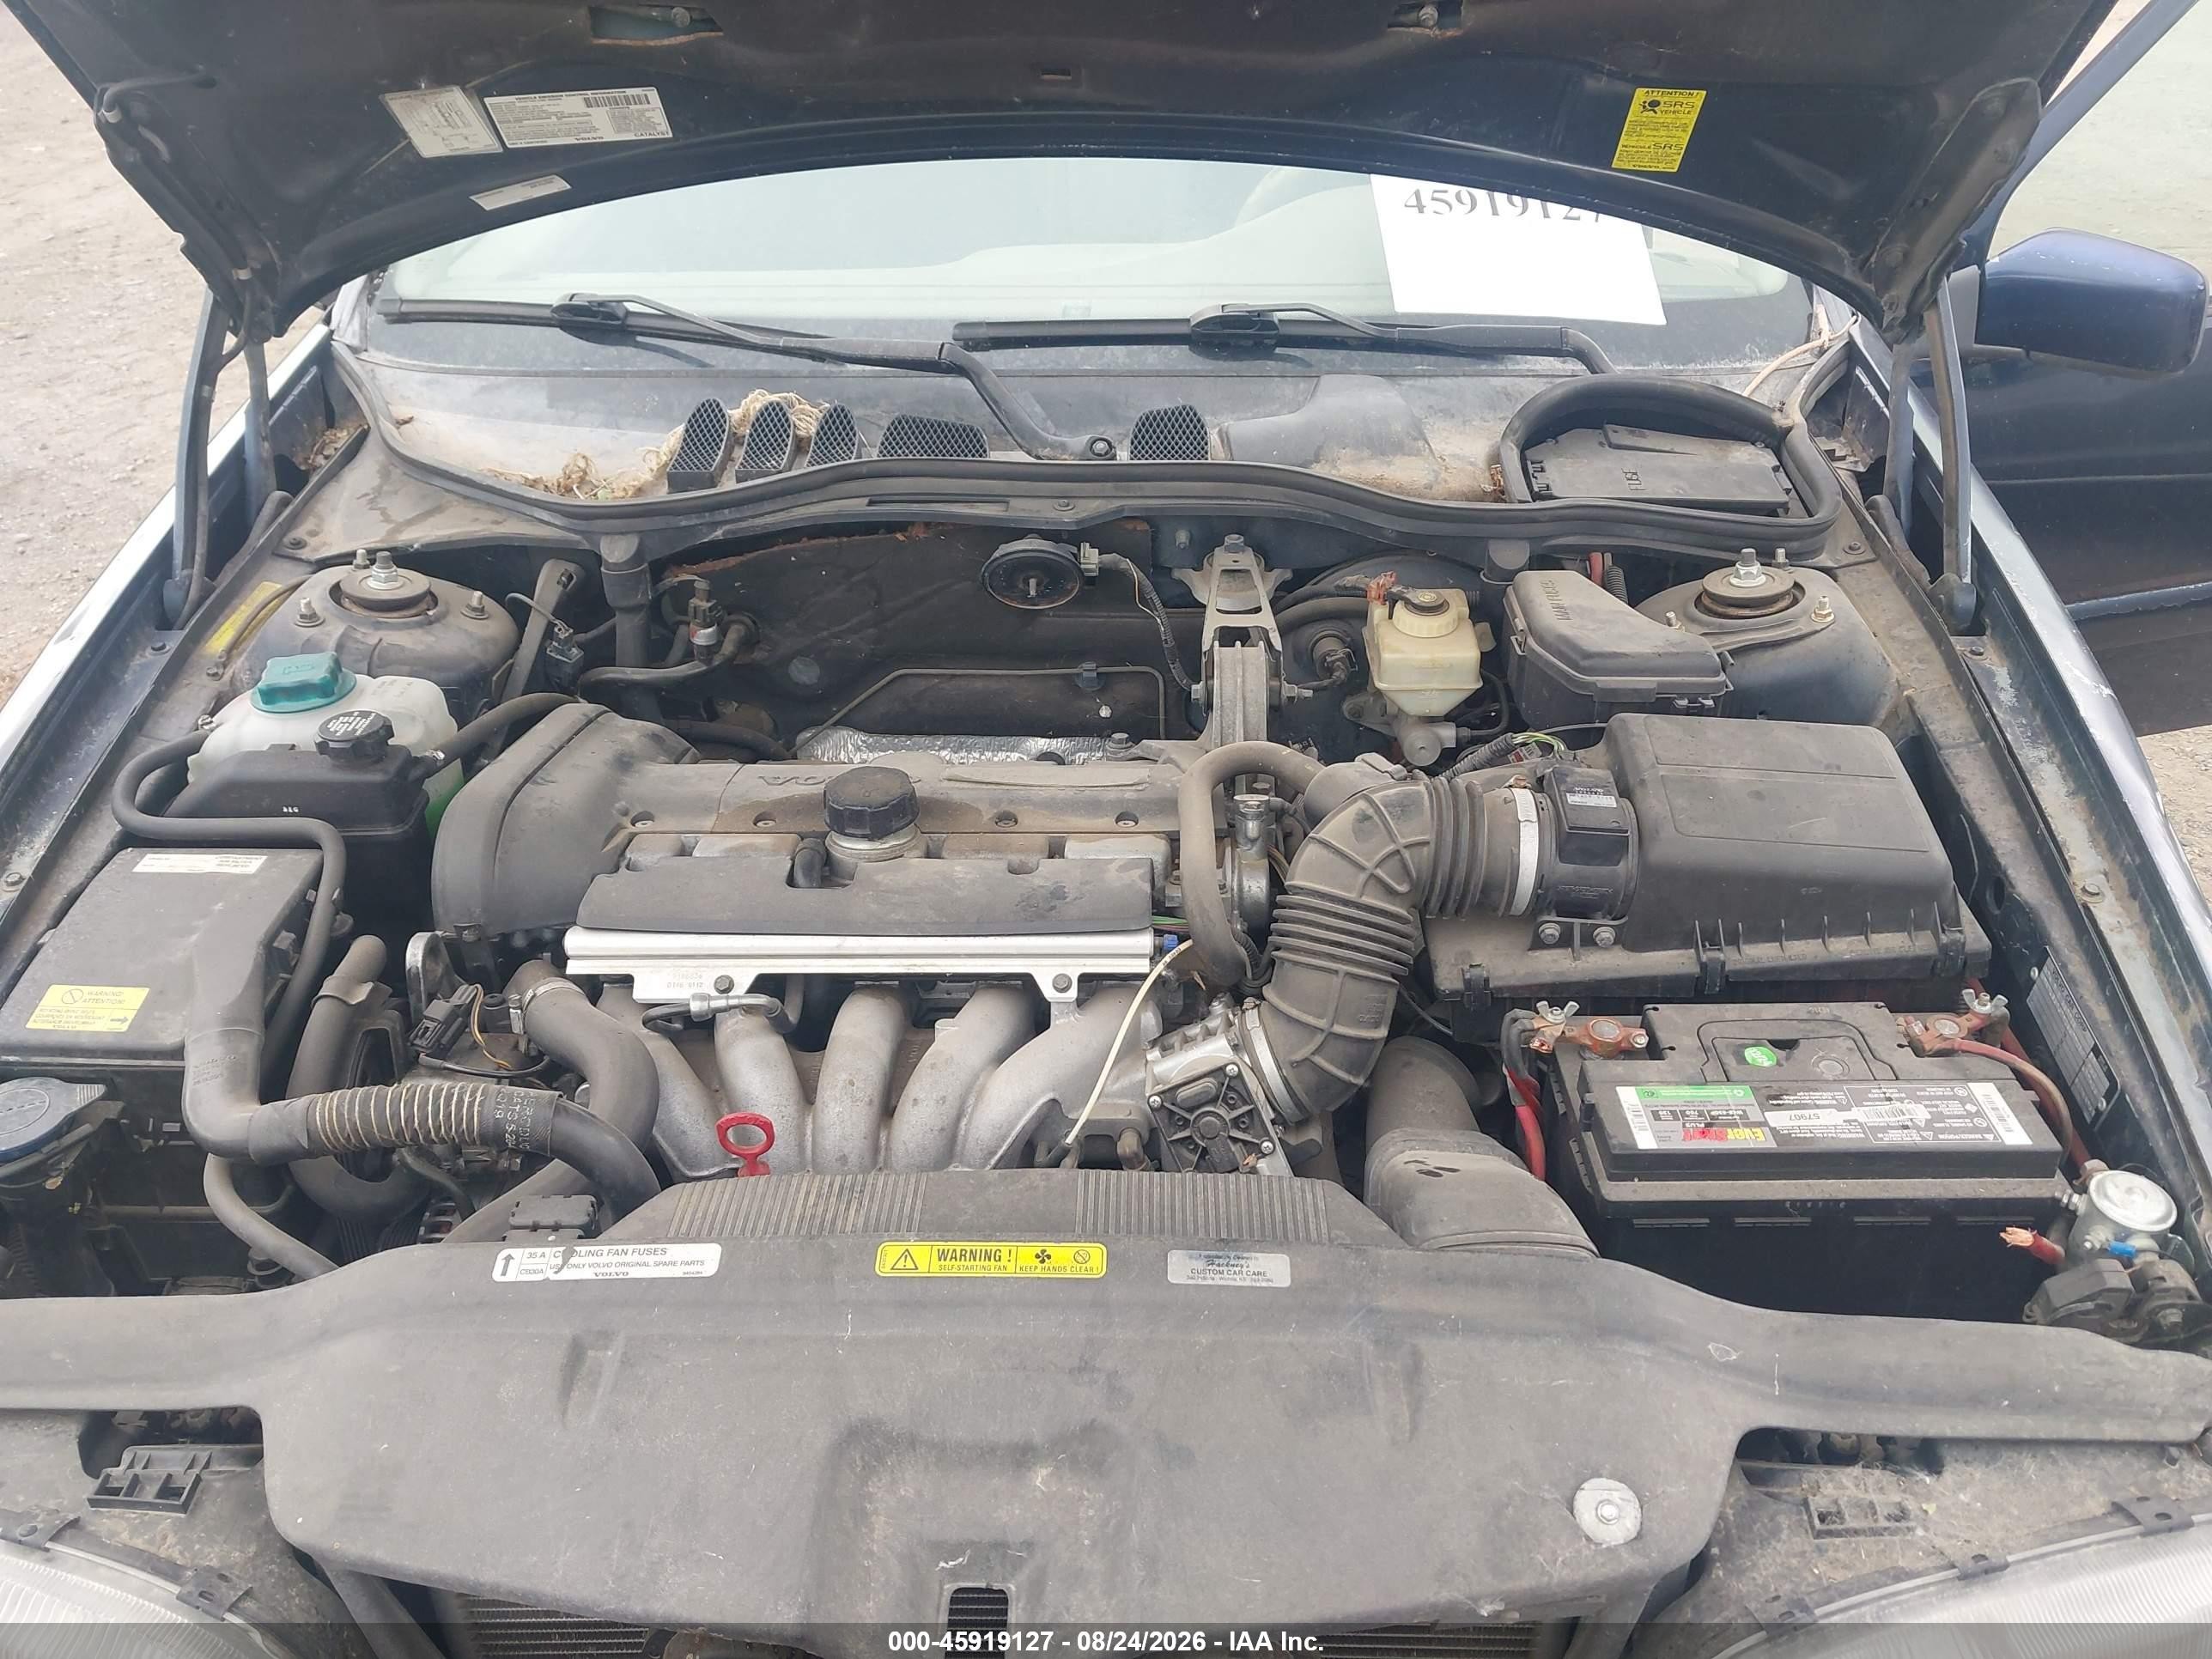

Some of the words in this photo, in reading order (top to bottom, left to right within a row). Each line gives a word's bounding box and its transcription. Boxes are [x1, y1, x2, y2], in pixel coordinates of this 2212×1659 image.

[1662, 100, 1695, 109] SRS
[1653, 143, 1684, 151] SRS
[1621, 466, 1647, 492] FUSE
[1789, 1113, 1820, 1121] 57907
[526, 1250, 538, 1259] 35
[538, 1250, 546, 1259] A
[553, 1249, 605, 1259] COLING
[606, 1248, 628, 1257] FAN
[631, 1247, 667, 1256] FUSES
[937, 1248, 1002, 1263] WARNING
[1006, 1248, 1012, 1263] !
[1190, 1267, 1224, 1276] CUSTOM
[1247, 1269, 1268, 1278] CARE
